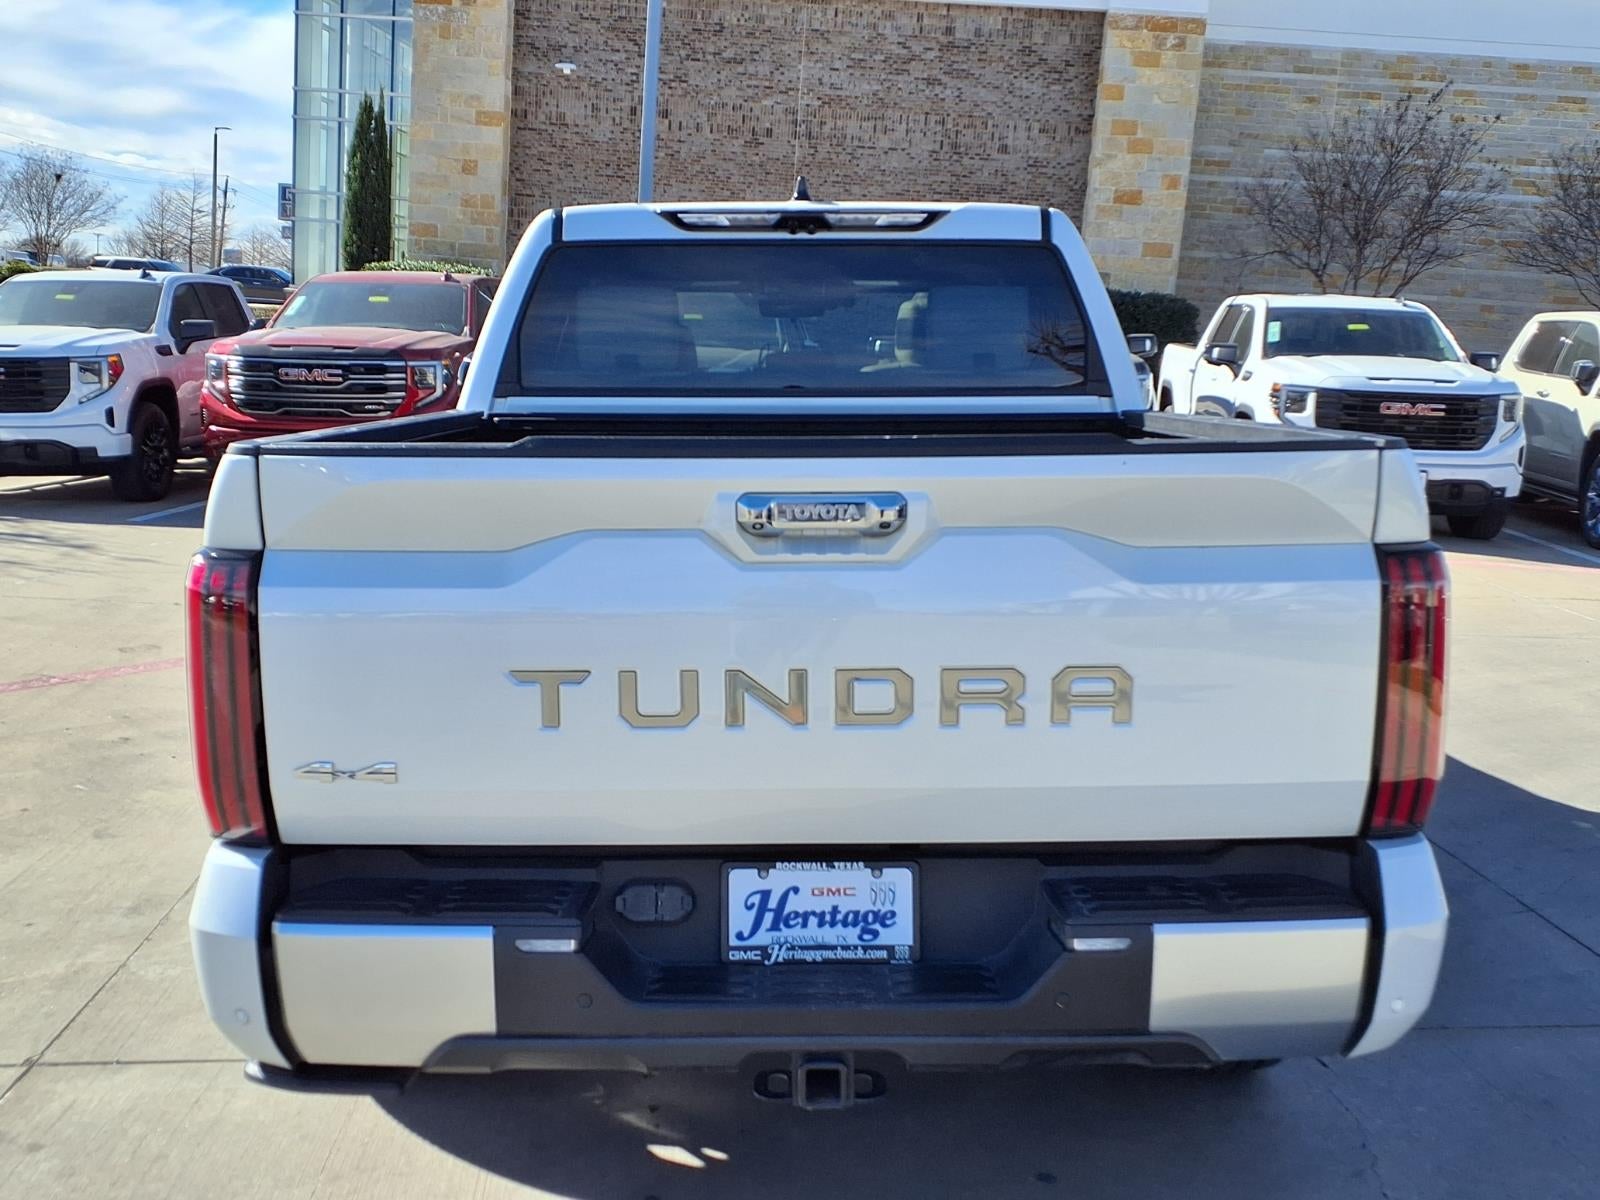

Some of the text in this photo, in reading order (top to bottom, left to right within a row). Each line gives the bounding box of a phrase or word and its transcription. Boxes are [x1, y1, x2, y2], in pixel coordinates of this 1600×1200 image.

[279, 367, 343, 382] GMC
[1379, 401, 1447, 416] GMC
[784, 504, 860, 521] TOYOTA
[508, 665, 1134, 729] TUNDRA
[833, 861, 865, 871] TEXAS
[811, 887, 857, 897] GMC
[735, 885, 897, 942] Heritage
[835, 935, 849, 944] TX
[729, 950, 762, 961] GMC
